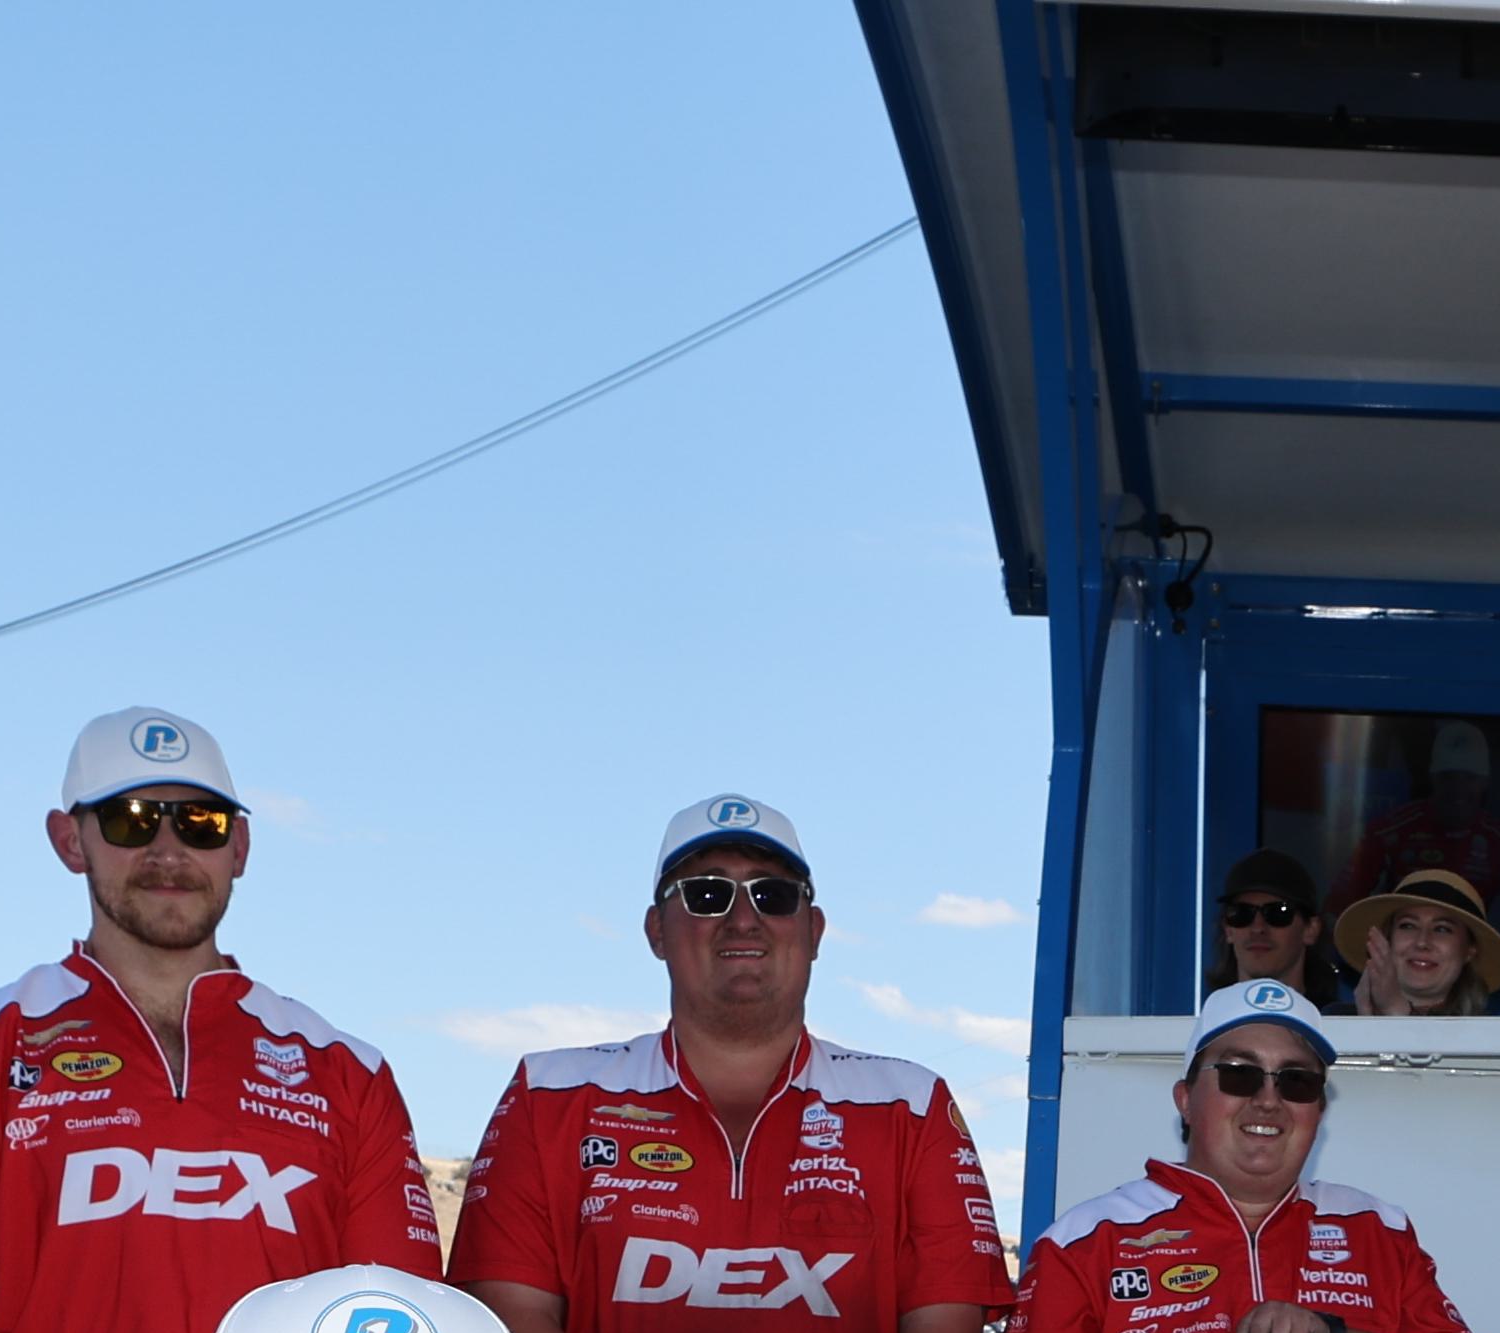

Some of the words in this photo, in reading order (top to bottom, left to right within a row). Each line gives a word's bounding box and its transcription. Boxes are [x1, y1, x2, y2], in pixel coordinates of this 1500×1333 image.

[60, 1056, 114, 1074] PENNZOIL
[18, 1087, 112, 1110] Snap-on
[241, 1078, 329, 1113] verizon
[65, 1112, 131, 1130] Clarience
[239, 1097, 330, 1138] HITACHI
[589, 1117, 679, 1136] CHEVROLET
[581, 1139, 617, 1166] PPG
[637, 1150, 687, 1164] PENNZOIL
[57, 1146, 318, 1235] DEX
[591, 1172, 679, 1193] Snap-on
[631, 1203, 692, 1221] Clarience
[1119, 1247, 1199, 1260] CHEVROLET
[612, 1235, 857, 1318] DEX
[1111, 1270, 1148, 1298] PPG
[1167, 1269, 1214, 1288] PENNZOIL
[1300, 1267, 1368, 1287] verizon
[1297, 1289, 1373, 1309] HITACHI
[1128, 1296, 1210, 1323] Snap-on
